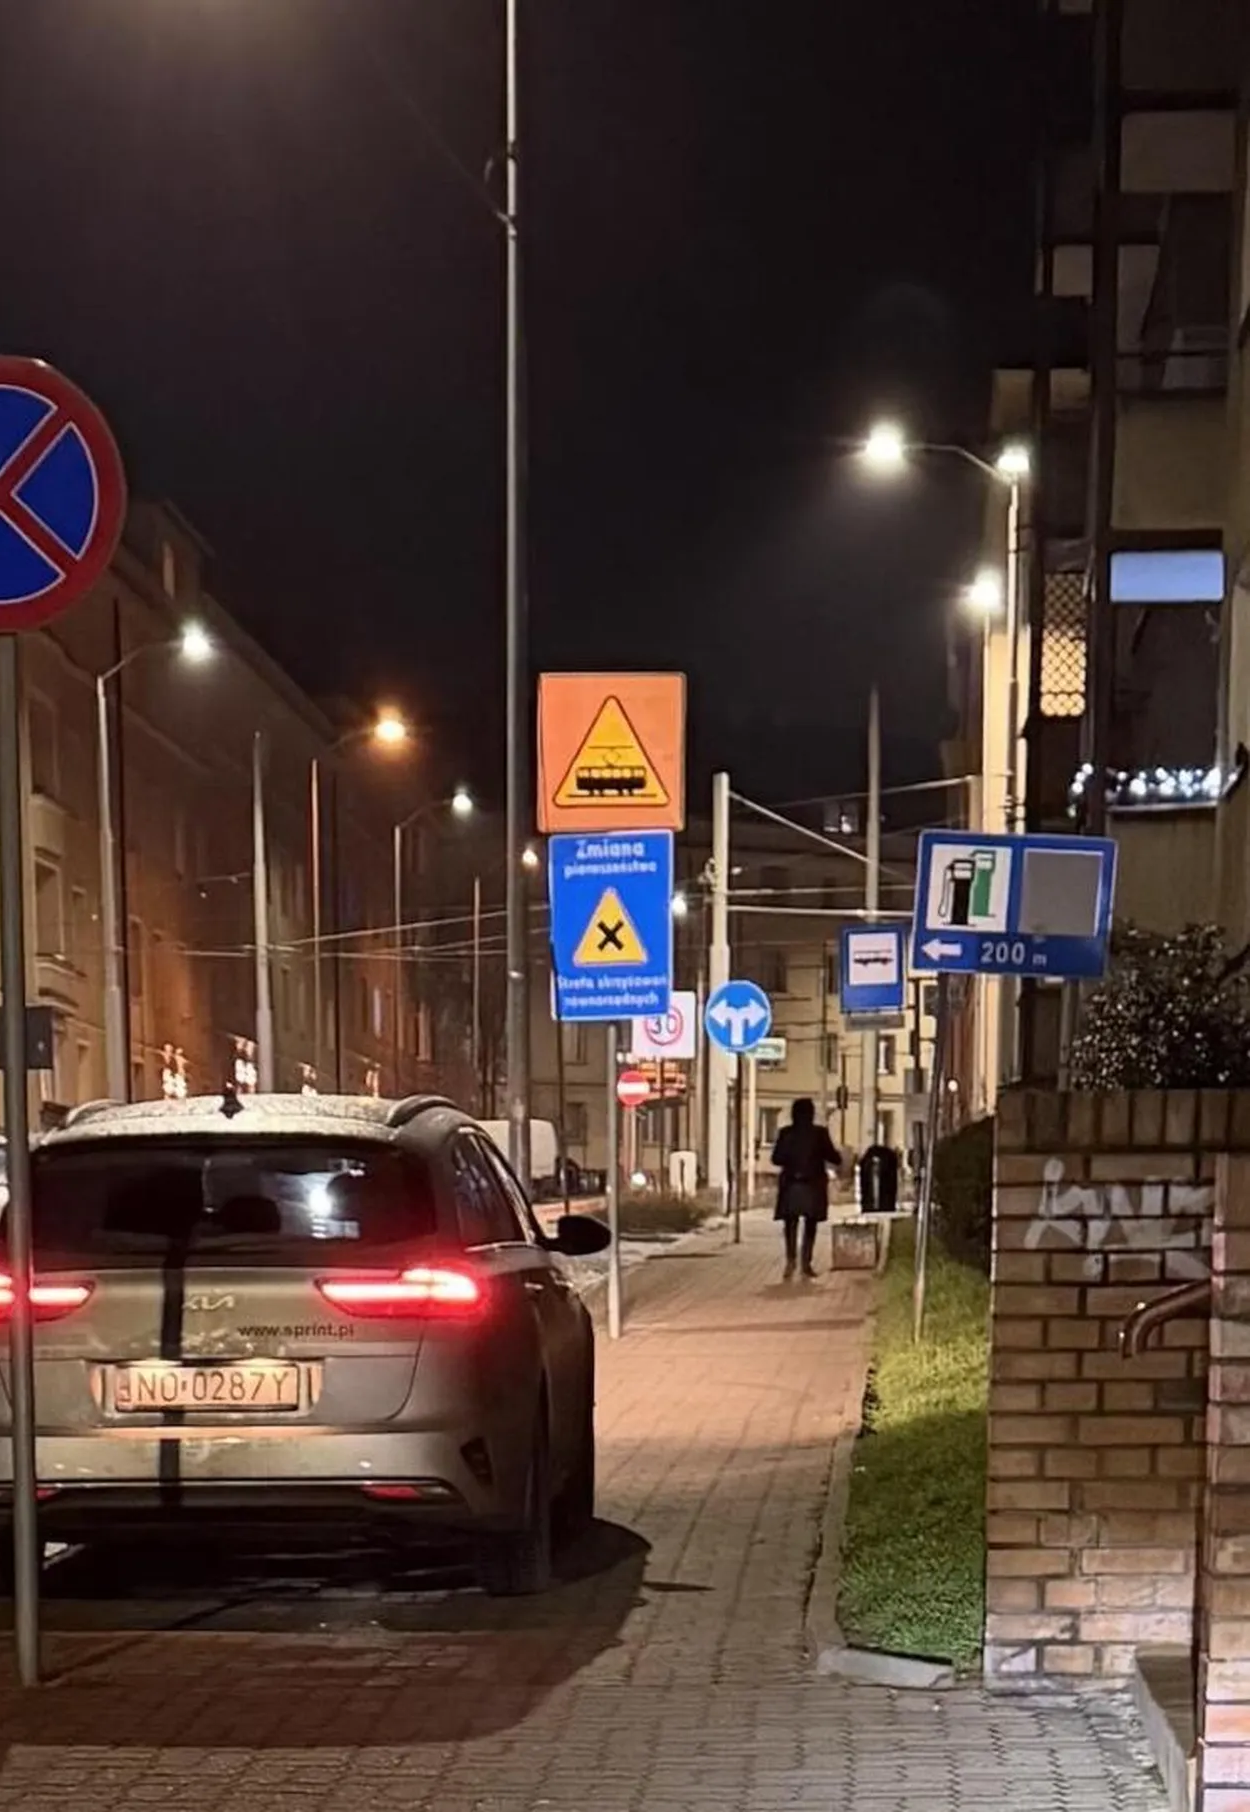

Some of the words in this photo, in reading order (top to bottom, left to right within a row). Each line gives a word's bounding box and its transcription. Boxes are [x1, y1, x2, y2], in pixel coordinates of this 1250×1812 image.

[575, 839, 645, 860] Zmiana
[980, 942, 1025, 965] 200
[1032, 953, 1048, 967] m
[650, 1014, 677, 1035] 30
[237, 1323, 354, 1339] www.sprint.pl
